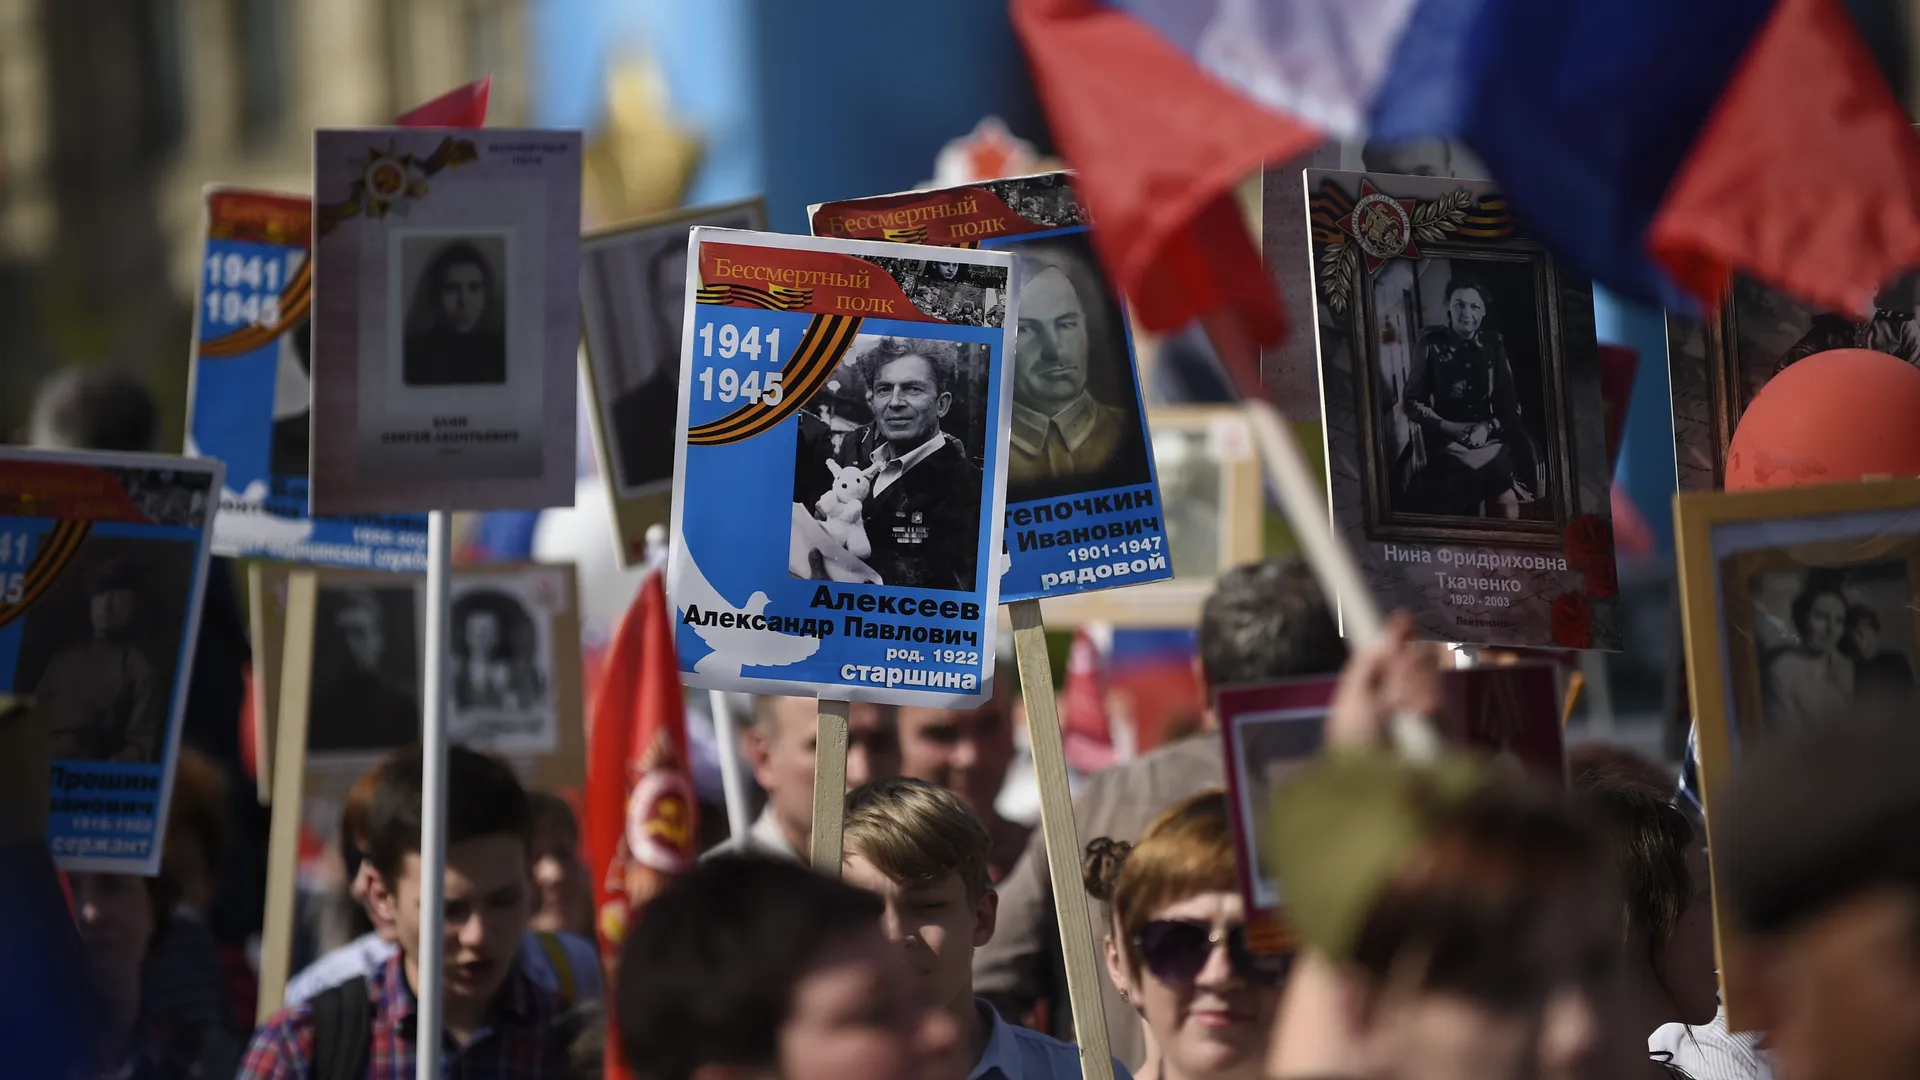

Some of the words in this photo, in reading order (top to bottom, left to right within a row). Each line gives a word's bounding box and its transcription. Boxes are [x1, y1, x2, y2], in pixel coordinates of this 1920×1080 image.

[828, 195, 979, 235] Бессмертный
[949, 217, 1007, 238] полк
[206, 251, 279, 292] 1941
[713, 257, 871, 289] Бессмертный
[205, 288, 282, 332] 1945
[835, 296, 895, 314] полк
[699, 322, 781, 362] 1941
[699, 366, 784, 406] 1945
[1016, 516, 1160, 552] Иванович
[1067, 536, 1162, 563] 1901-1947
[1384, 544, 1432, 563] Нина
[1437, 548, 1568, 571] Фридриховна
[1040, 552, 1167, 591] рядовой
[1435, 571, 1522, 593] Ткаченко
[809, 585, 980, 621] Алексеев
[1450, 594, 1475, 606] 1920
[1485, 596, 1510, 608] 2003
[682, 604, 834, 639] Александр
[843, 616, 978, 647] Павлович
[886, 647, 925, 663] род.
[933, 649, 979, 666] 1922
[840, 662, 978, 690] старшина
[50, 765, 160, 794] Прошин
[51, 836, 149, 858] сержант
